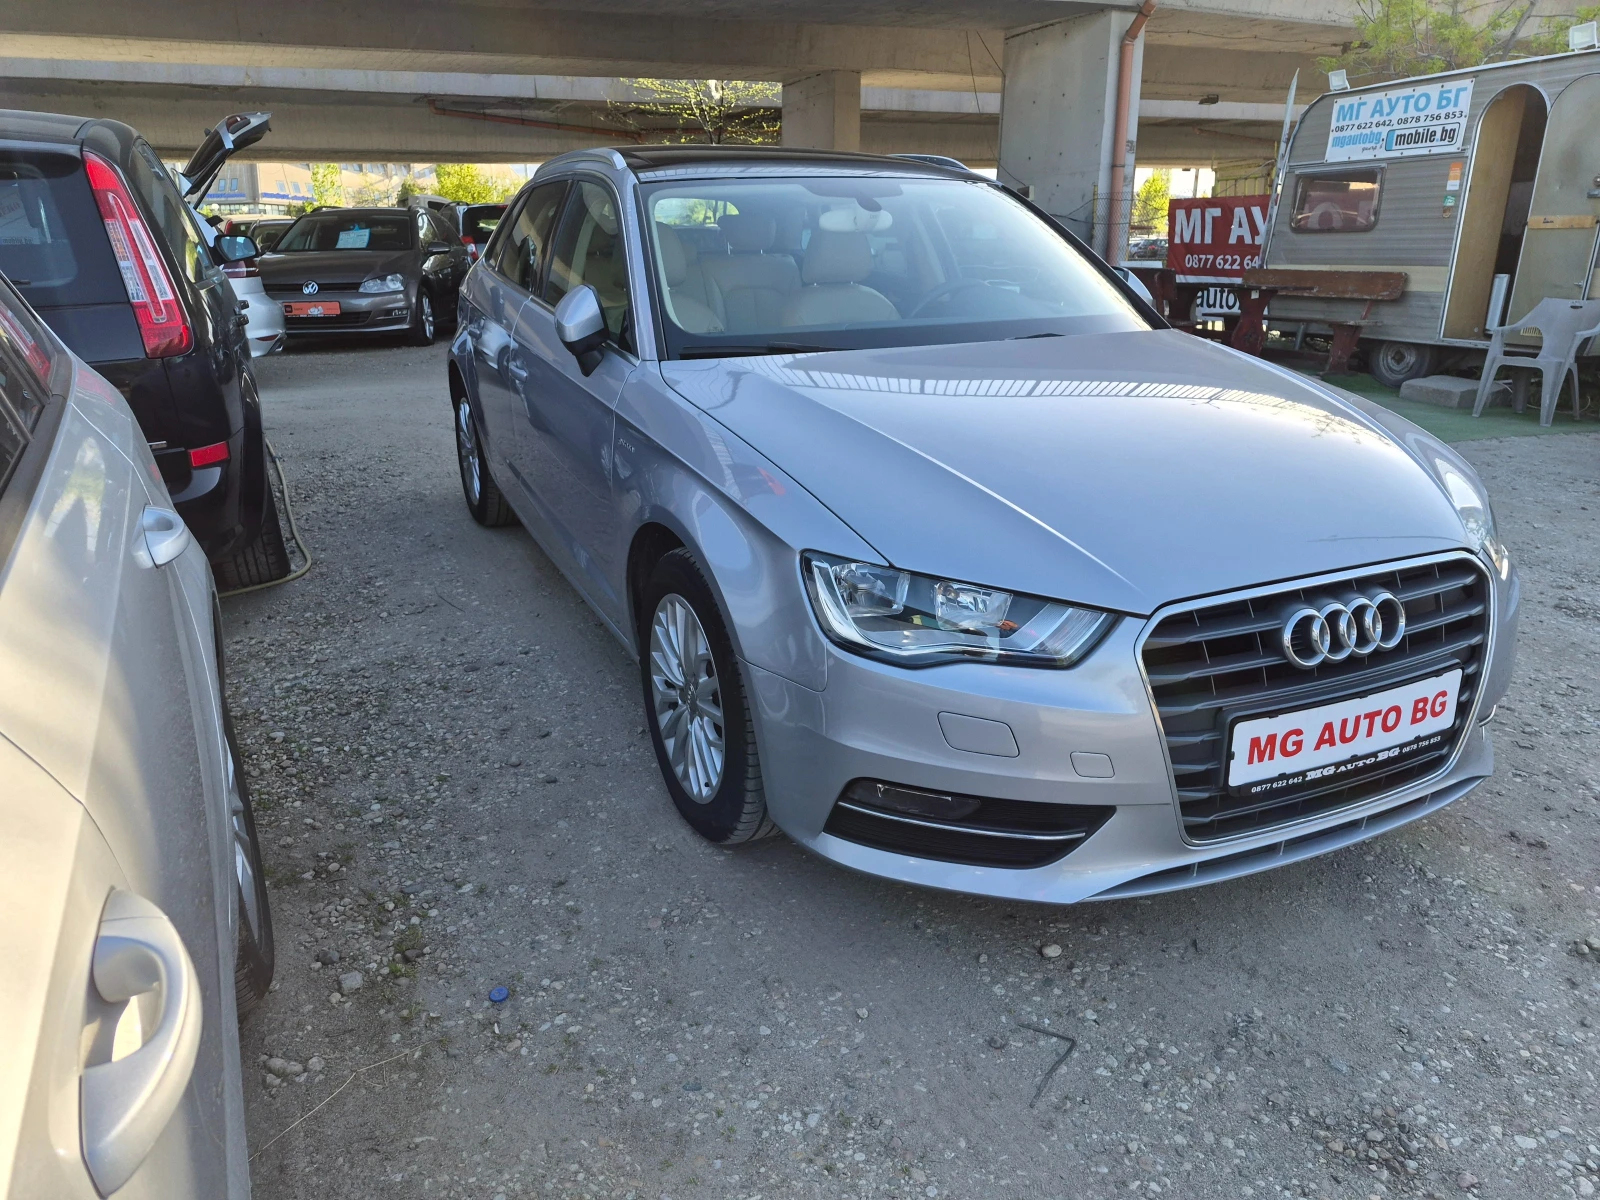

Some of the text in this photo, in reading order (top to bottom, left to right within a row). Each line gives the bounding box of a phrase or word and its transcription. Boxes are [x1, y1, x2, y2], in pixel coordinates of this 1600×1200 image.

[1336, 87, 1468, 123] МГ АУТО БГ
[1334, 123, 1356, 133] 0877
[1357, 121, 1374, 130] 622
[1397, 115, 1421, 125] 0878
[1423, 113, 1442, 122] 756
[1444, 110, 1464, 120] 853
[1394, 126, 1457, 146] mobile.bg
[1174, 208, 1222, 244] МГ
[1185, 254, 1214, 268] 0877
[1215, 255, 1241, 269] 622
[1196, 287, 1241, 311] auto
[1247, 690, 1448, 765] MG AUTO BG
[1251, 783, 1272, 793] 0877
[1272, 779, 1287, 788] 622
[1305, 765, 1336, 781] MG
[1336, 758, 1376, 773] AUTO
[1376, 746, 1401, 761] BG
